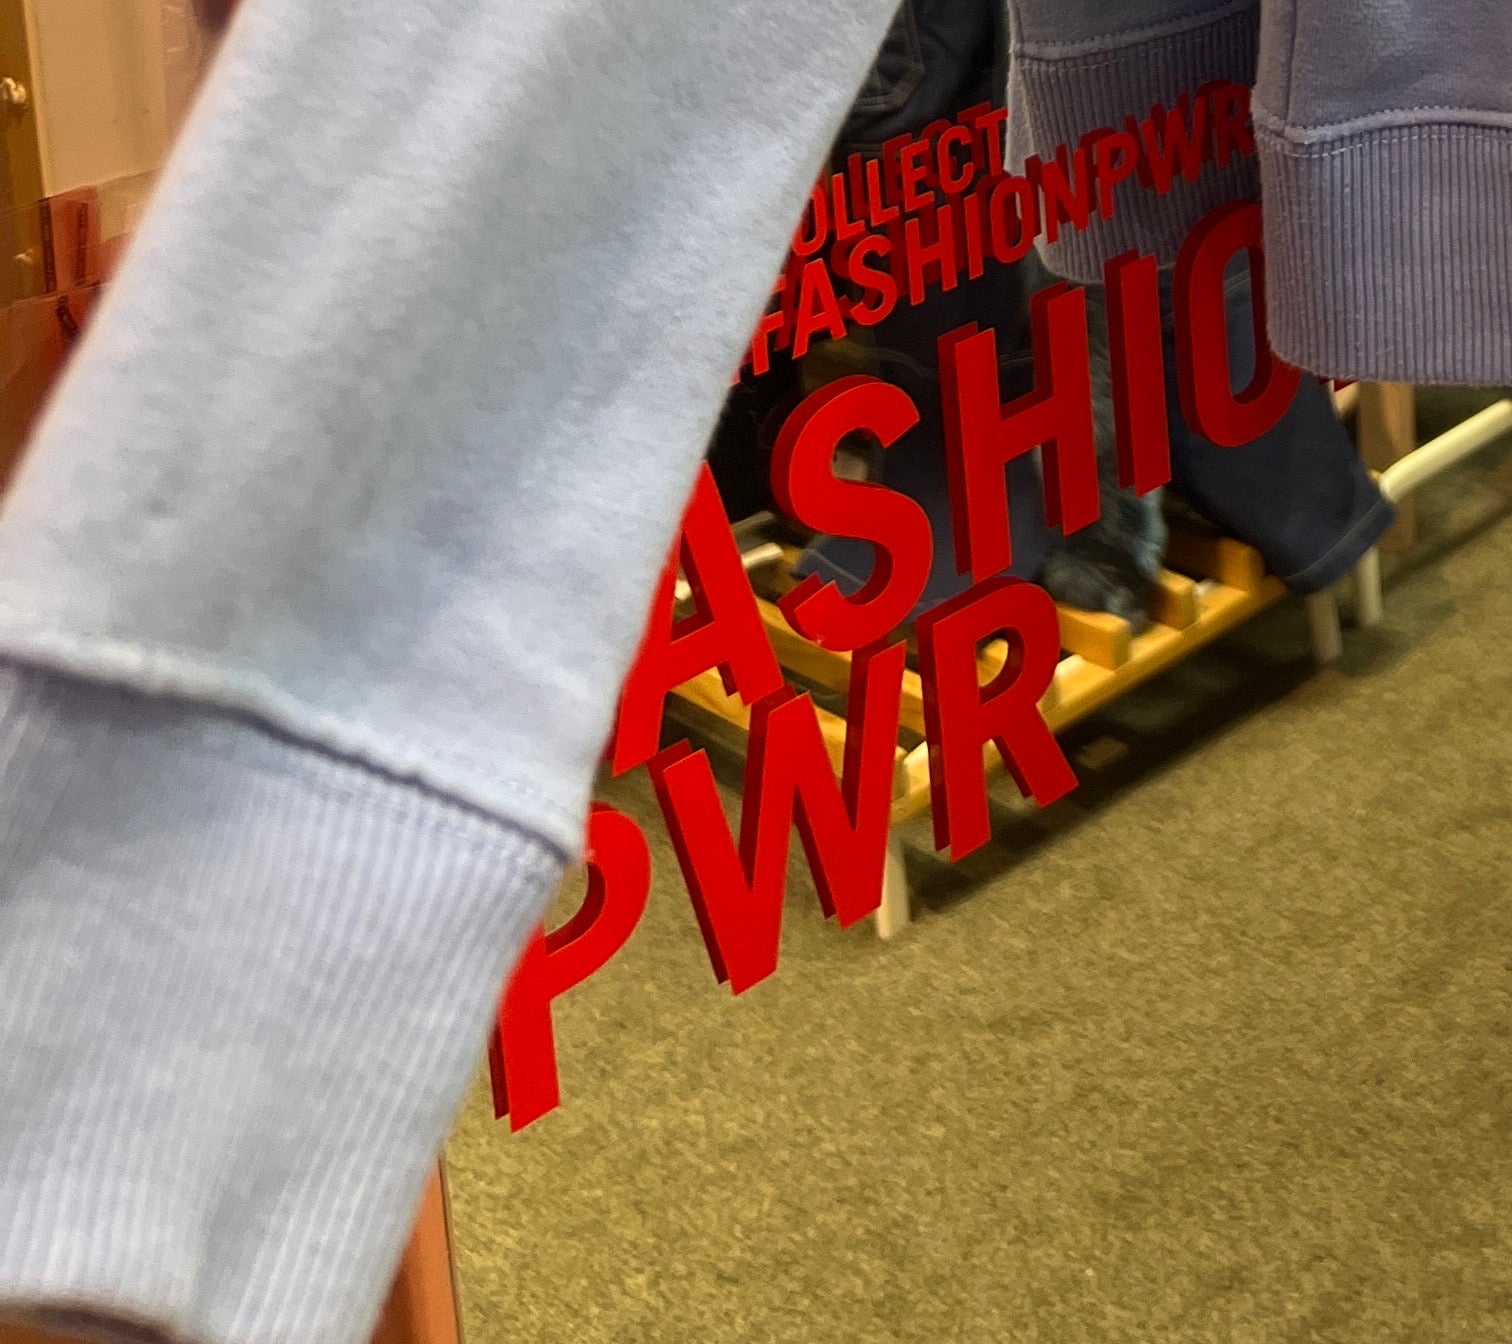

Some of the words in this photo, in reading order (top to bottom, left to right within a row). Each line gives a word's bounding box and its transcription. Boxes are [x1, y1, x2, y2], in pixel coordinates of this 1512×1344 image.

[728, 81, 1257, 387] FASHIONPWR
[789, 105, 1009, 257] OLLECT
[606, 202, 1303, 776] ASHIO
